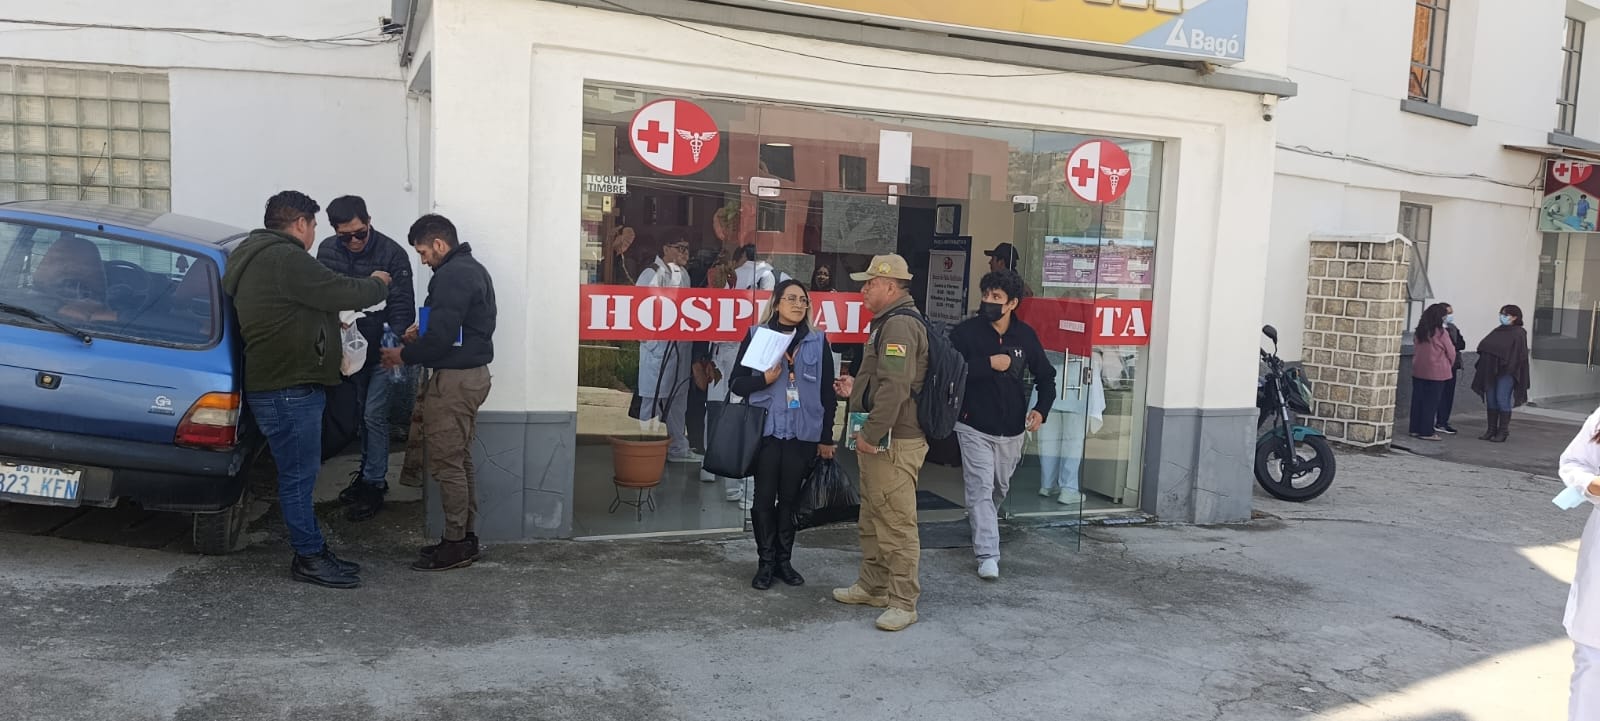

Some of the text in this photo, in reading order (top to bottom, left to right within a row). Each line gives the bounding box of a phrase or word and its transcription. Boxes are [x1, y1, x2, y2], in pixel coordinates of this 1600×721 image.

[1190, 28, 1239, 57] Bagó
[588, 183, 625, 194] TIMBRE
[590, 175, 624, 185] TOQUE
[587, 293, 872, 334] HOSPAL
